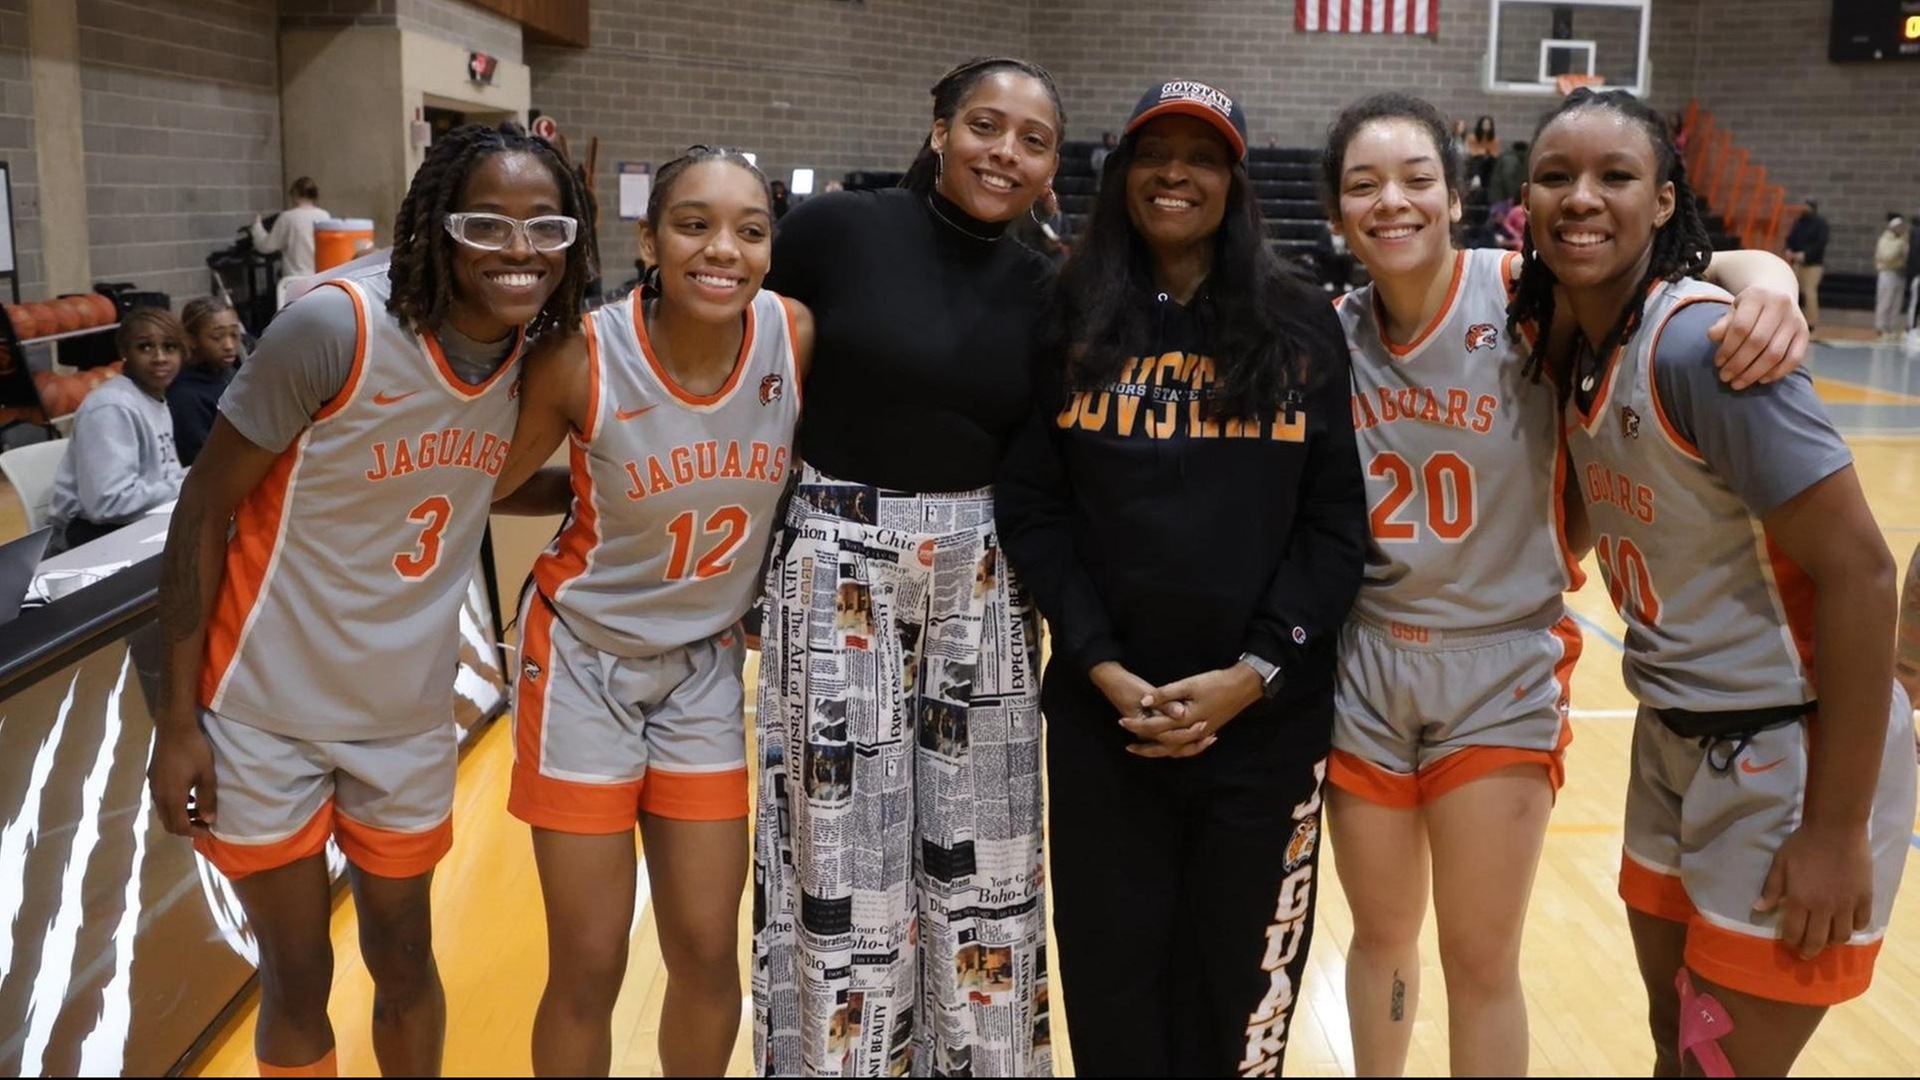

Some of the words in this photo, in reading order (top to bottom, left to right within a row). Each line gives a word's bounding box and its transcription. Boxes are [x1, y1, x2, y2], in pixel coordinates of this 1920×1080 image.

[1161, 81, 1233, 110] GOVSTATE
[1349, 386, 1499, 434] JAGUARS
[365, 427, 511, 482] JAGUARS
[624, 439, 787, 501] JAGUARS
[1367, 451, 1478, 543] 20
[392, 494, 454, 582] 3
[662, 504, 751, 582] 12
[791, 608, 804, 638] The
[1391, 621, 1428, 644] GSU
[790, 643, 805, 676] Art
[1009, 612, 1025, 689] EXPECTANT
[789, 681, 801, 699] of
[790, 702, 803, 780] Fashion
[870, 1004, 887, 1053] BEAUTY
